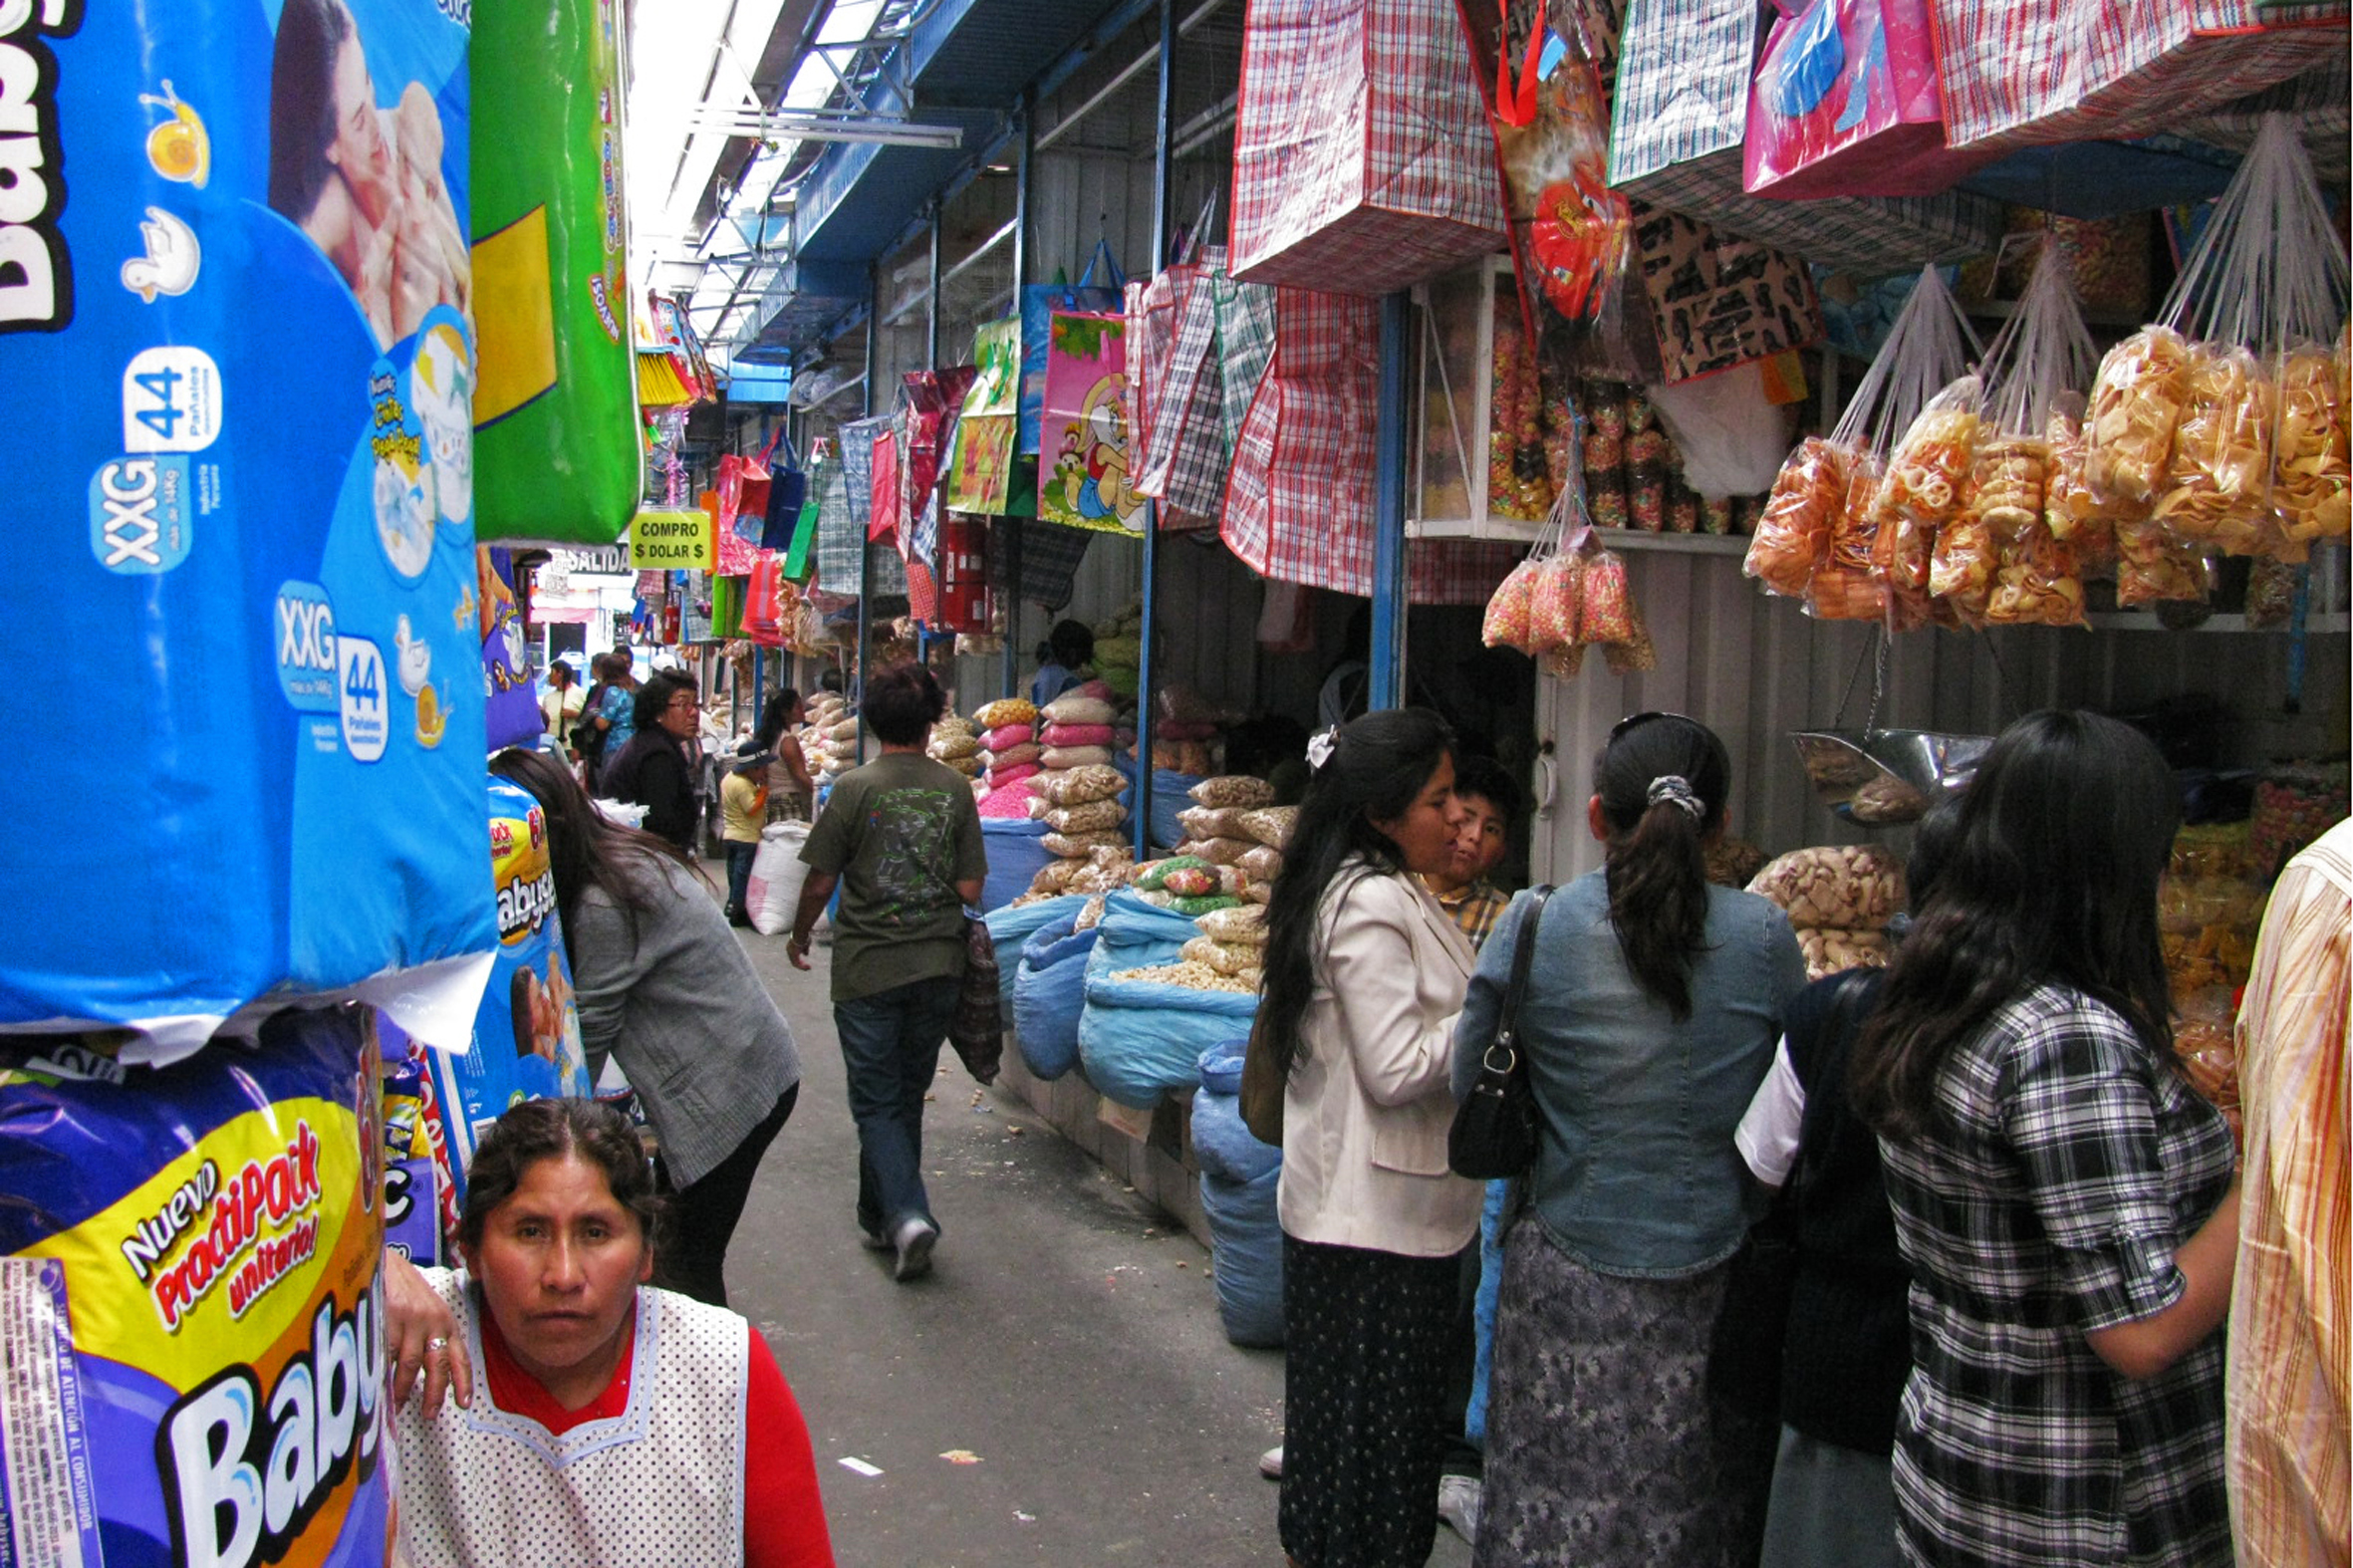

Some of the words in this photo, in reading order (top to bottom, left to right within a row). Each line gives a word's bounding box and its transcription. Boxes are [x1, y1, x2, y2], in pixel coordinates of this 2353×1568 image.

[133, 366, 184, 439] 44
[101, 459, 161, 566] XXG
[641, 522, 699, 537] COMPRO
[566, 545, 633, 574] SALIDA
[635, 543, 646, 560] $
[649, 544, 689, 558] DOLAR
[693, 543, 704, 560] $
[279, 597, 337, 671] XXG
[347, 653, 380, 711] 44
[121, 1160, 216, 1281] Nuevo
[164, 1267, 385, 1568] Baby
[72, 1455, 93, 1530] CONSUMIDOR
